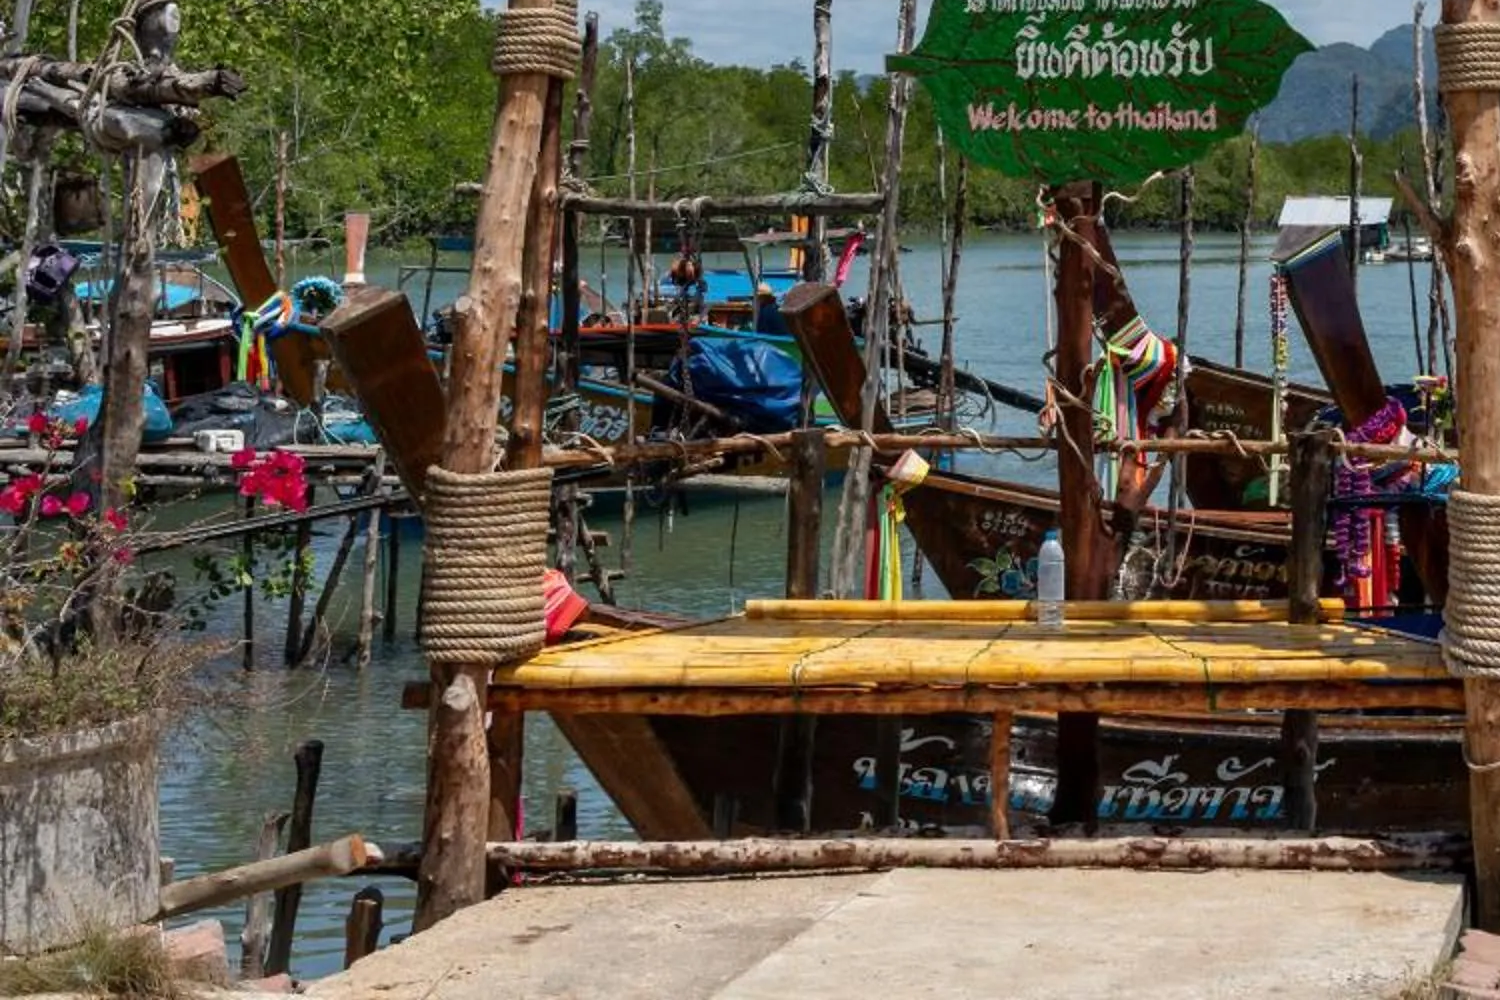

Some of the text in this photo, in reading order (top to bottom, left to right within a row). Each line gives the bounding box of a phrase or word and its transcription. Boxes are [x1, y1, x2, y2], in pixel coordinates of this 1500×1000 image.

[1014, 20, 1214, 80] ยินดีต้อนรับ
[968, 101, 1081, 132] Welcome
[1083, 102, 1112, 131] to
